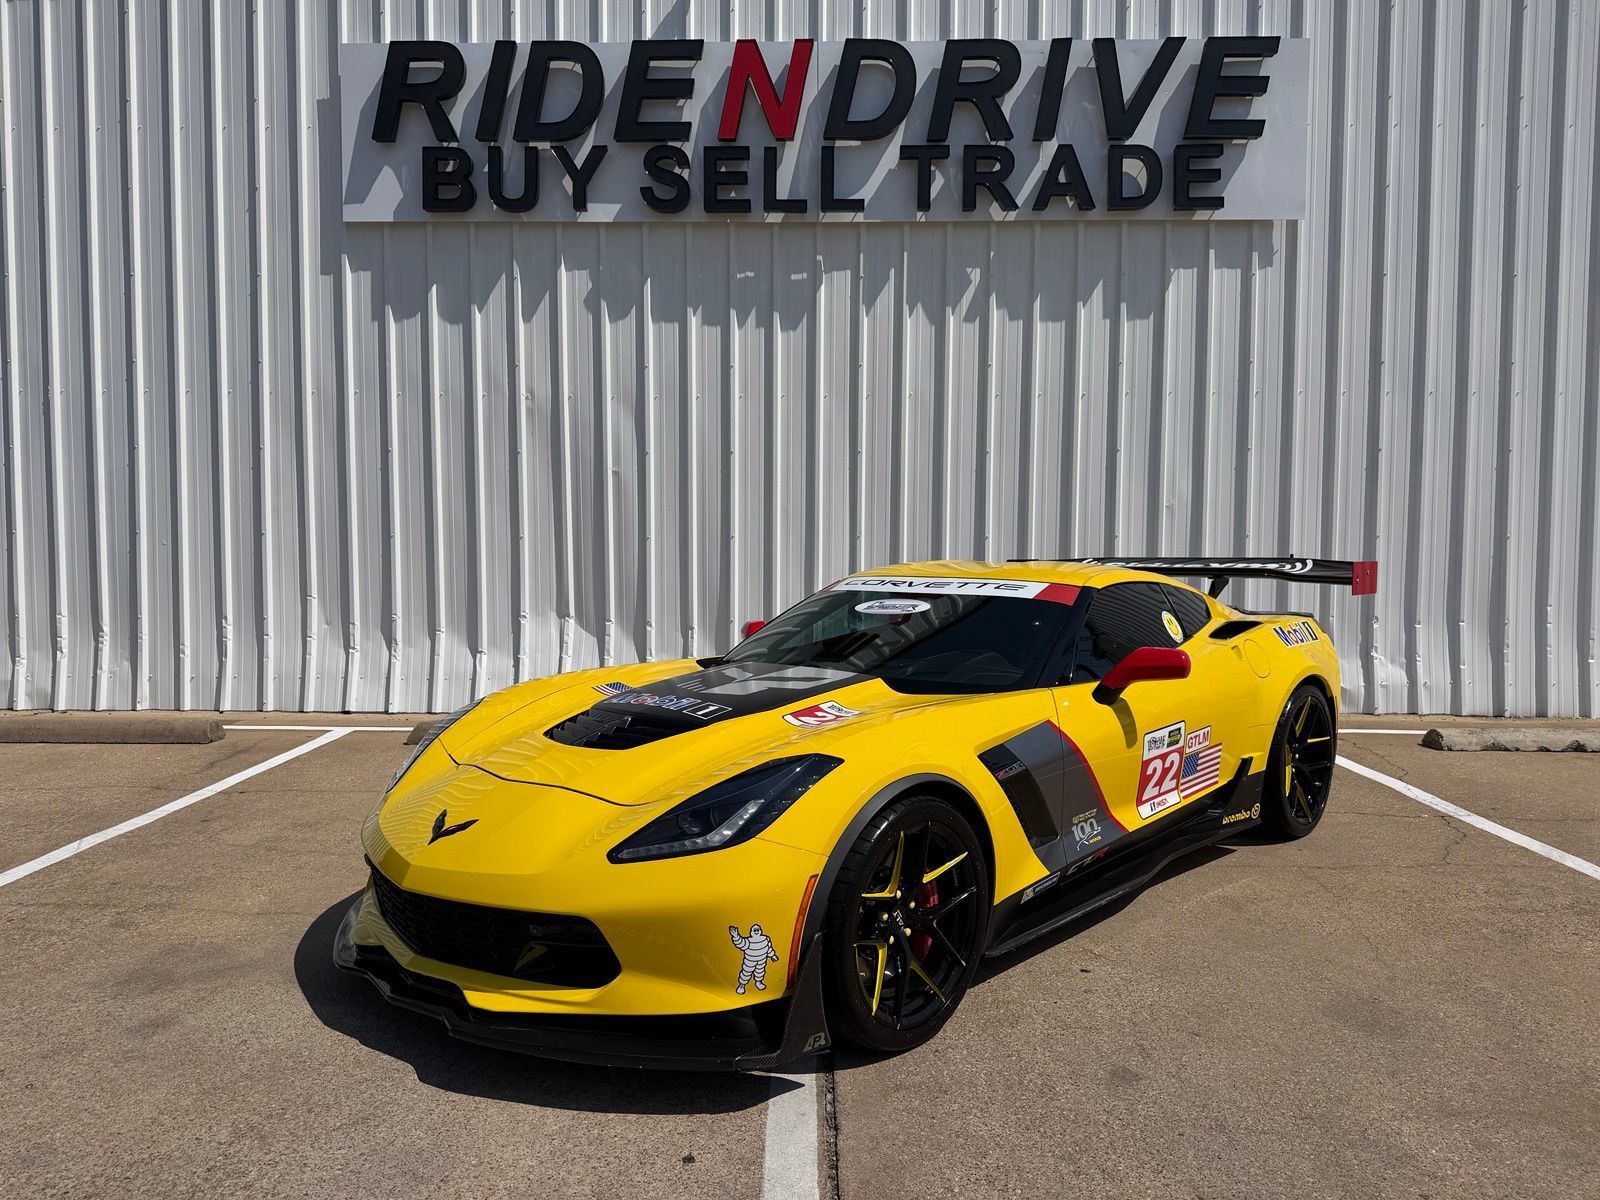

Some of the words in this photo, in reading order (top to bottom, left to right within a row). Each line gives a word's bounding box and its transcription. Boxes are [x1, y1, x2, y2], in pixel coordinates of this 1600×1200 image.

[422, 145, 608, 213] BUY
[640, 145, 865, 214] SELL
[900, 144, 1225, 211] TRADE
[844, 579, 1029, 592] CORVETTE
[1272, 622, 1310, 647] Mobil
[1187, 730, 1210, 750] GTLM
[1142, 752, 1180, 801] 22
